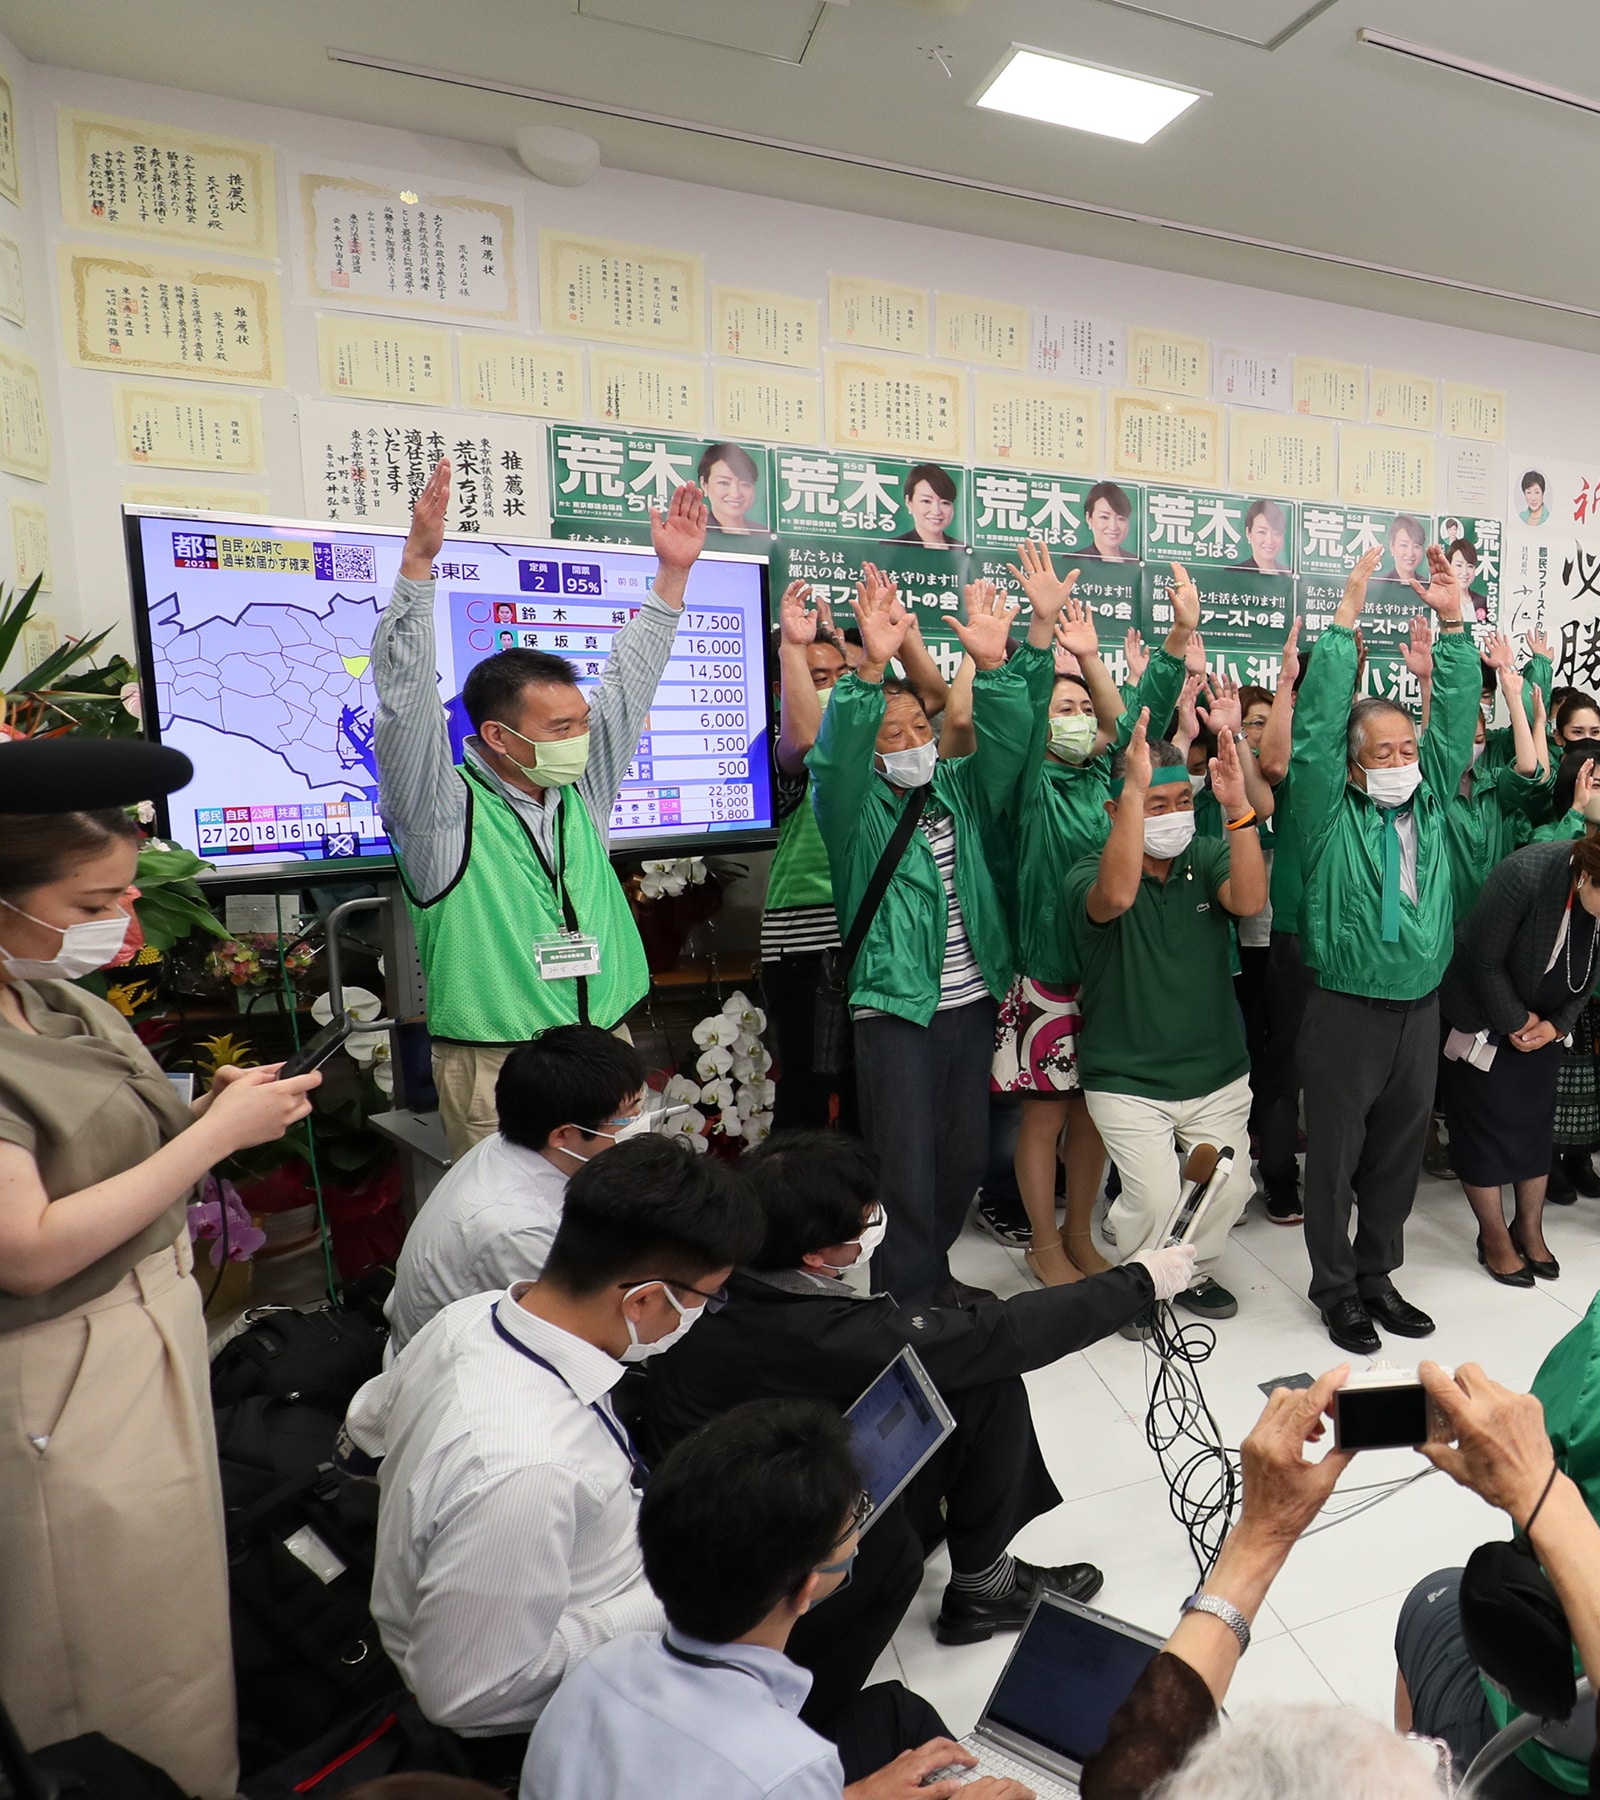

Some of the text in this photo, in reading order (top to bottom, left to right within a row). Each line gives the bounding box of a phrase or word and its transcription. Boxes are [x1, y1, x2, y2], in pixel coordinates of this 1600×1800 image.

[226, 173, 247, 214] 推薦状
[481, 234, 496, 276] 推薦状
[234, 307, 250, 345] 推薦状
[628, 441, 652, 450] あらき
[383, 427, 403, 495] いたします
[557, 434, 692, 497] 荒木
[843, 463, 865, 471] あらき
[453, 439, 481, 532] 荒木ちはる殿
[479, 438, 494, 518] 東京都議会議員候補
[501, 450, 527, 517] 推薦状
[780, 456, 900, 515] 荒木
[573, 502, 623, 512] 東京都議会議員
[624, 493, 669, 514] ちは
[976, 475, 1081, 531] 荒木
[839, 511, 896, 532] ちはる
[1149, 494, 1242, 545] 荒木
[1027, 527, 1078, 546] ちはる
[1303, 509, 1385, 558] 荒木
[174, 535, 202, 559] 都
[221, 538, 283, 556] 自民・公明で
[1193, 541, 1238, 559] ちはる
[1475, 520, 1500, 580] 荒木
[184, 560, 211, 568] 2021
[222, 554, 310, 572] 過半数届かず確実
[314, 546, 323, 570] 詳しく
[323, 548, 333, 576] ネットで
[788, 549, 844, 564] 私たちは
[528, 562, 549, 573] 定員
[571, 565, 591, 576] 開票
[534, 577, 545, 590] 2
[566, 578, 600, 593] 95%
[1306, 586, 1345, 598] 私たちは
[1487, 582, 1498, 622] ちはる
[687, 614, 740, 631] 17,500
[688, 640, 741, 655] 16,000
[689, 664, 742, 680] 14,500
[691, 689, 743, 704] 12,000
[700, 713, 744, 729] 6,000
[703, 737, 745, 753] 1,500
[718, 761, 746, 776] 500
[709, 786, 748, 796] 22,500
[710, 797, 748, 808] 16,000
[199, 809, 222, 821] 都民
[226, 809, 249, 821] 自民
[251, 808, 274, 820] 公明
[277, 807, 299, 819] 共産
[302, 806, 324, 818] 立民
[327, 804, 348, 816] 維新
[711, 810, 749, 820] 15,800
[202, 821, 365, 844] 27 20 18 16 10 1 1
